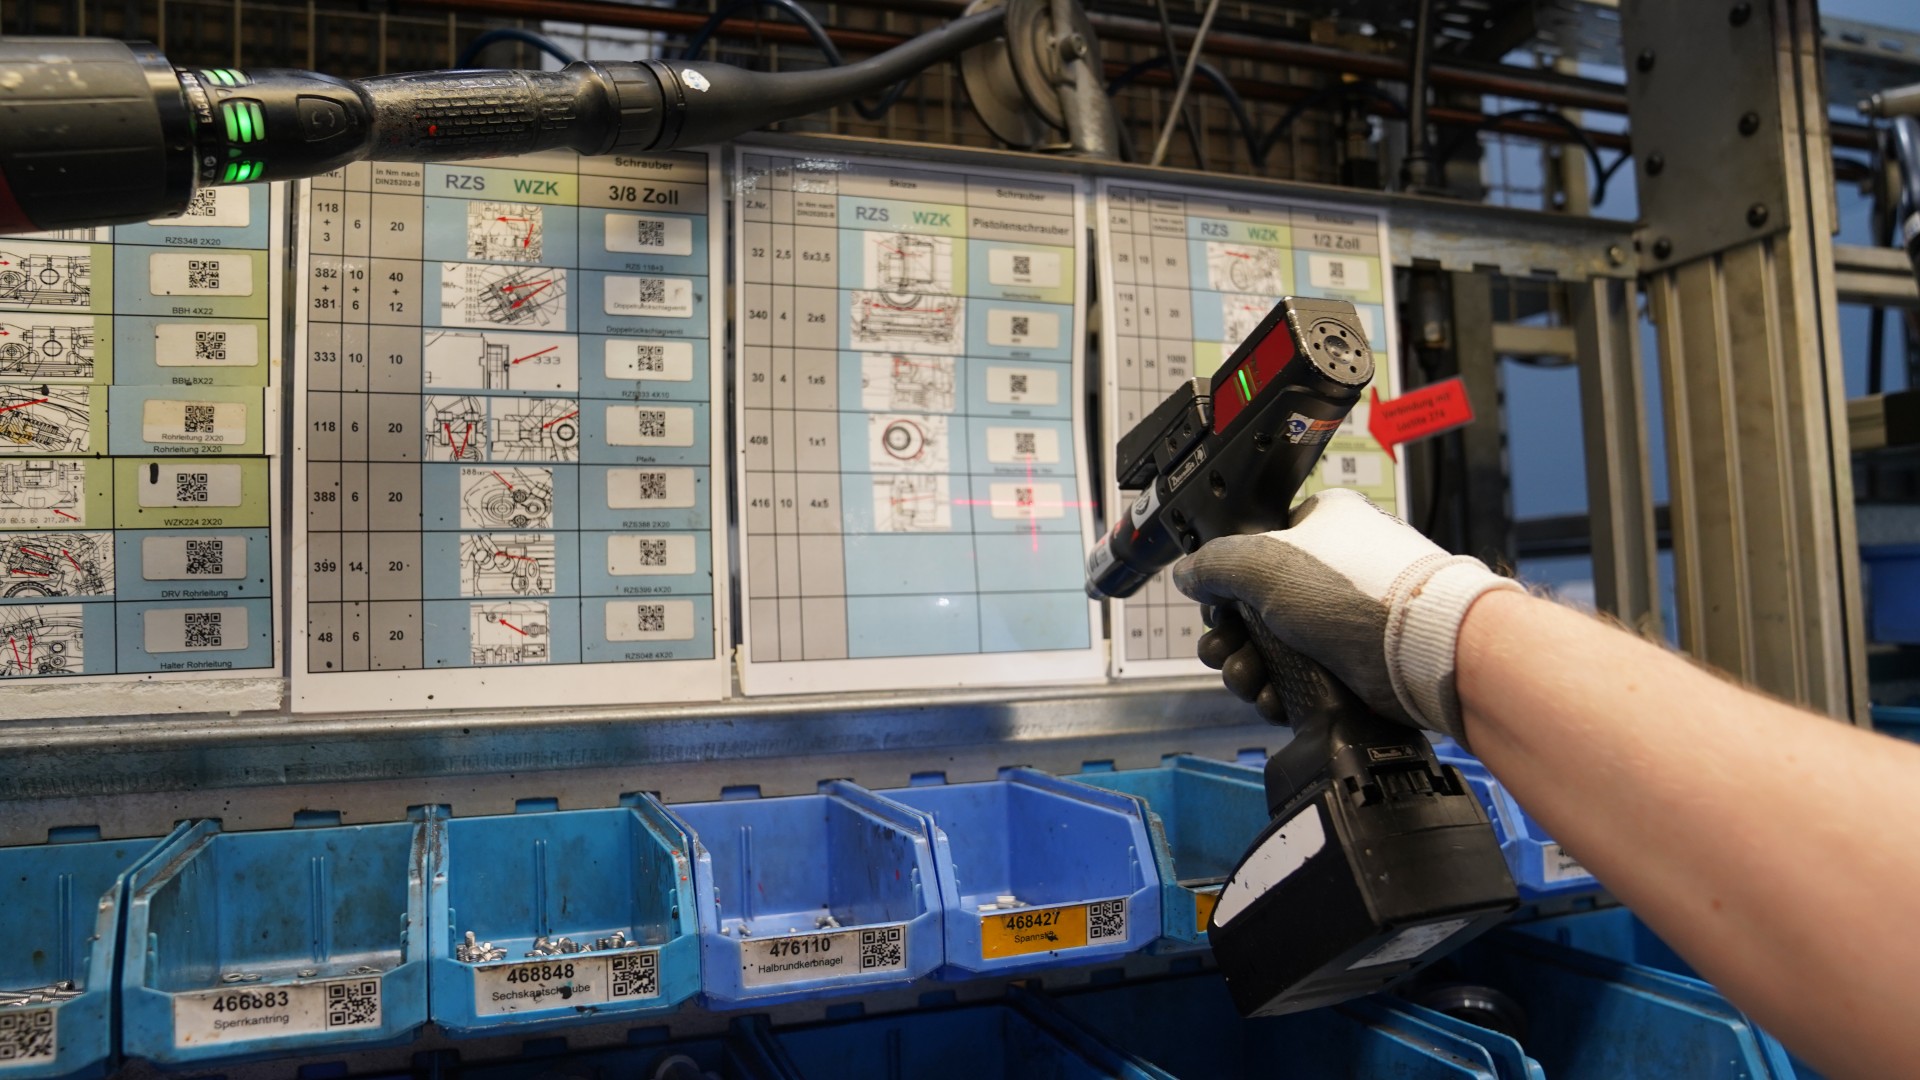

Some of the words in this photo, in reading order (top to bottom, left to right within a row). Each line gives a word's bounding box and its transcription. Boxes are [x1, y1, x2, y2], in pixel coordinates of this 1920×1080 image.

[615, 157, 674, 170] Schrauber
[401, 170, 420, 178] nach
[446, 174, 485, 191] RZS
[514, 178, 559, 196] WZK
[609, 185, 637, 202] 3/8
[643, 187, 678, 205] Zoll
[996, 189, 1045, 201] Schrauber
[317, 203, 339, 213] 118
[856, 206, 889, 222] RZS
[913, 211, 951, 228] WZK
[354, 220, 361, 229] 6
[390, 222, 405, 232] 20
[972, 218, 1070, 236] Pistolenschrauber
[323, 232, 331, 242] 3
[1201, 222, 1229, 237] RZS
[1248, 227, 1279, 242] WZK
[165, 236, 198, 245] RZS348
[200, 237, 221, 246] 2X20
[1312, 233, 1332, 248] 1/2
[1336, 235, 1361, 250] Zoll
[752, 248, 765, 258] 32
[776, 250, 791, 260] 2,5
[315, 268, 338, 278] 382
[350, 270, 364, 280] 10
[389, 272, 404, 282] 40
[314, 299, 336, 309] 381
[352, 300, 360, 310] 6
[389, 303, 404, 312] 12
[172, 307, 191, 315] BBH
[192, 307, 213, 315] 4X22
[749, 311, 768, 320] 340
[779, 312, 787, 320] 4
[314, 352, 336, 362] 333
[349, 353, 363, 363] 10
[389, 354, 403, 364] 10
[534, 356, 561, 365] 333
[192, 377, 213, 385] 8X22
[752, 373, 764, 383] 30
[780, 375, 787, 383] 4
[313, 421, 336, 431] 118
[351, 423, 358, 432] 6
[388, 423, 402, 433] 20
[161, 433, 203, 443] Rohrleitung
[204, 434, 224, 442] 2X20
[750, 436, 768, 446] 408
[153, 445, 200, 455] Rohrleitung
[201, 446, 222, 454] 2X20
[313, 492, 336, 502] 388
[352, 492, 358, 502] 6
[388, 492, 402, 502] 20
[751, 499, 770, 508] 416
[781, 499, 793, 508] 10
[164, 518, 200, 526] WZK224
[201, 518, 223, 526] 2X20
[314, 562, 336, 572] 399
[349, 562, 363, 571] 14
[389, 561, 403, 571] 20
[161, 590, 181, 598] DRV
[182, 588, 228, 599] Rohrleitung
[318, 633, 333, 642] 48
[352, 632, 360, 641] 6
[390, 630, 404, 640] 20
[160, 661, 187, 670] Halter
[188, 660, 232, 670] Rohrleitung
[1006, 910, 1061, 930] 468427
[769, 938, 831, 958] 476110
[757, 955, 844, 974] Halbrundkerbnagel
[506, 963, 575, 984] 468848
[213, 991, 290, 1013] 466883
[213, 1013, 290, 1031] Sperrkantring
